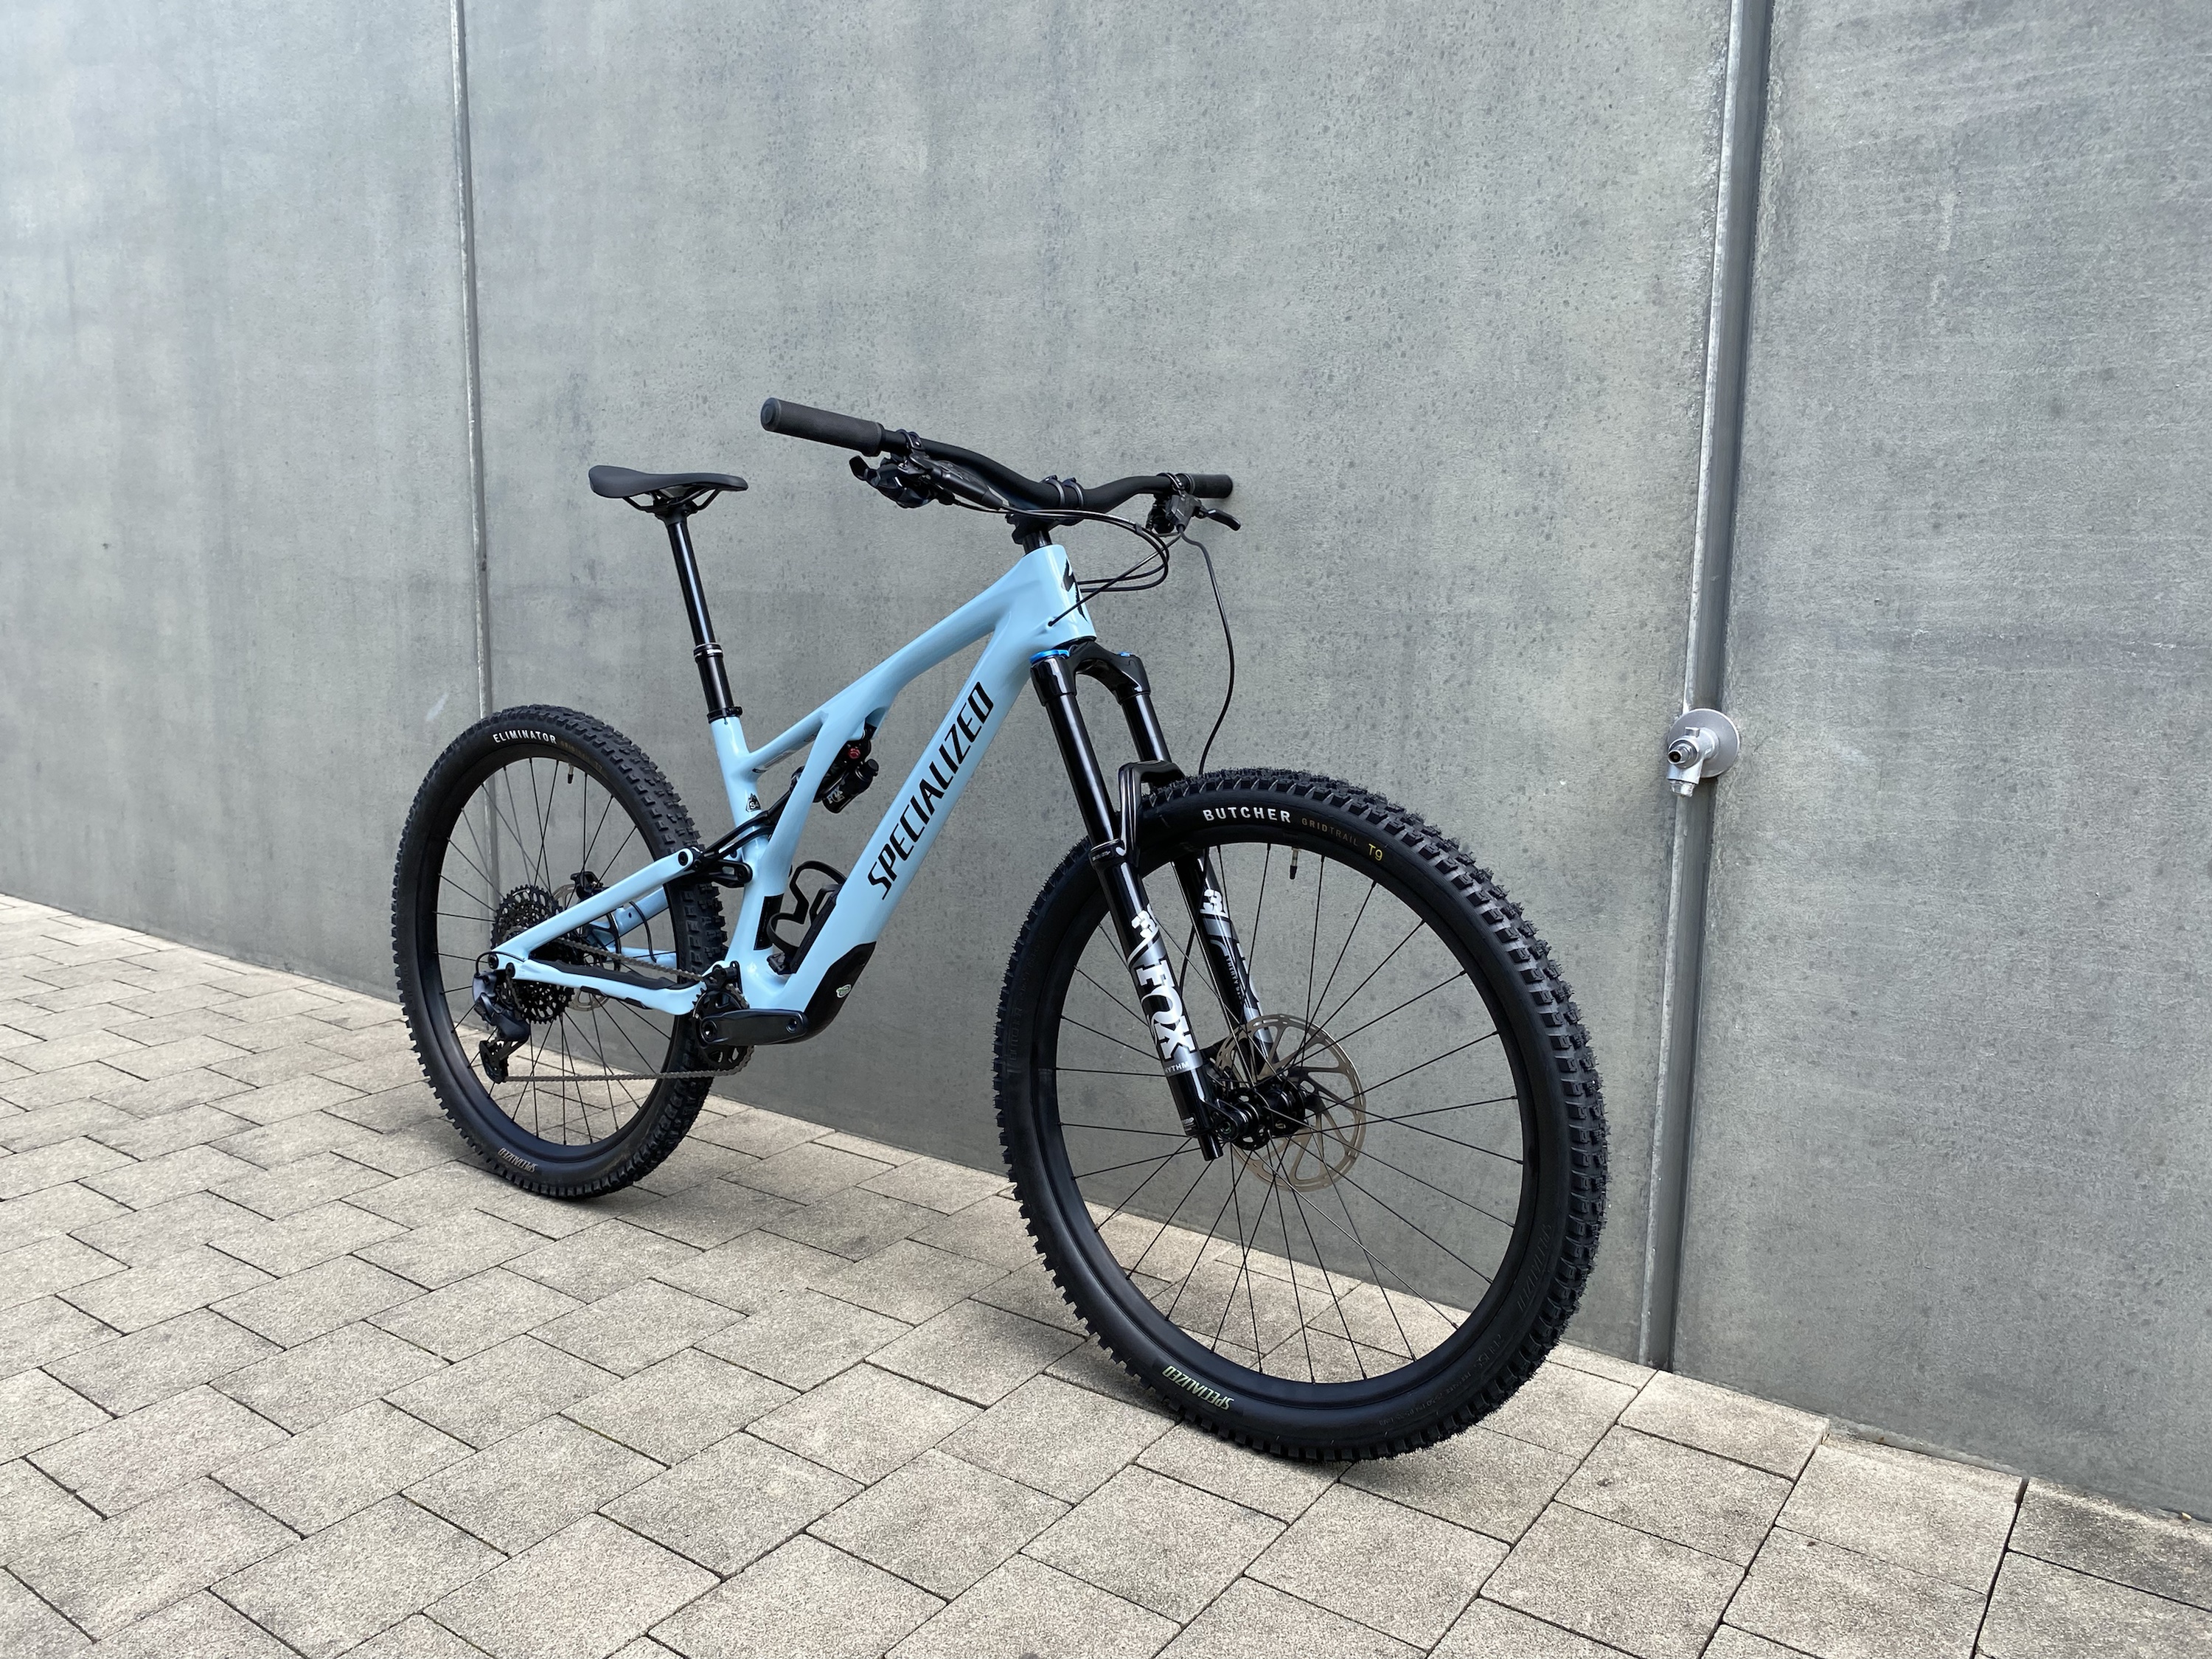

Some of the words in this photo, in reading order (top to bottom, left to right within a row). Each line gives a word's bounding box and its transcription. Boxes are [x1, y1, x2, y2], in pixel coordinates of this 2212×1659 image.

[493, 729, 557, 744] ELIMINATOR
[827, 785, 845, 804] FOX
[868, 681, 994, 900] SPECIALIZED
[1203, 807, 1290, 823] BUTCHER
[1368, 843, 1384, 861] T9
[1135, 959, 1196, 1060] FOX
[498, 1147, 538, 1172] SPECIALIZED
[1162, 1366, 1235, 1410] SPECIALIZED
